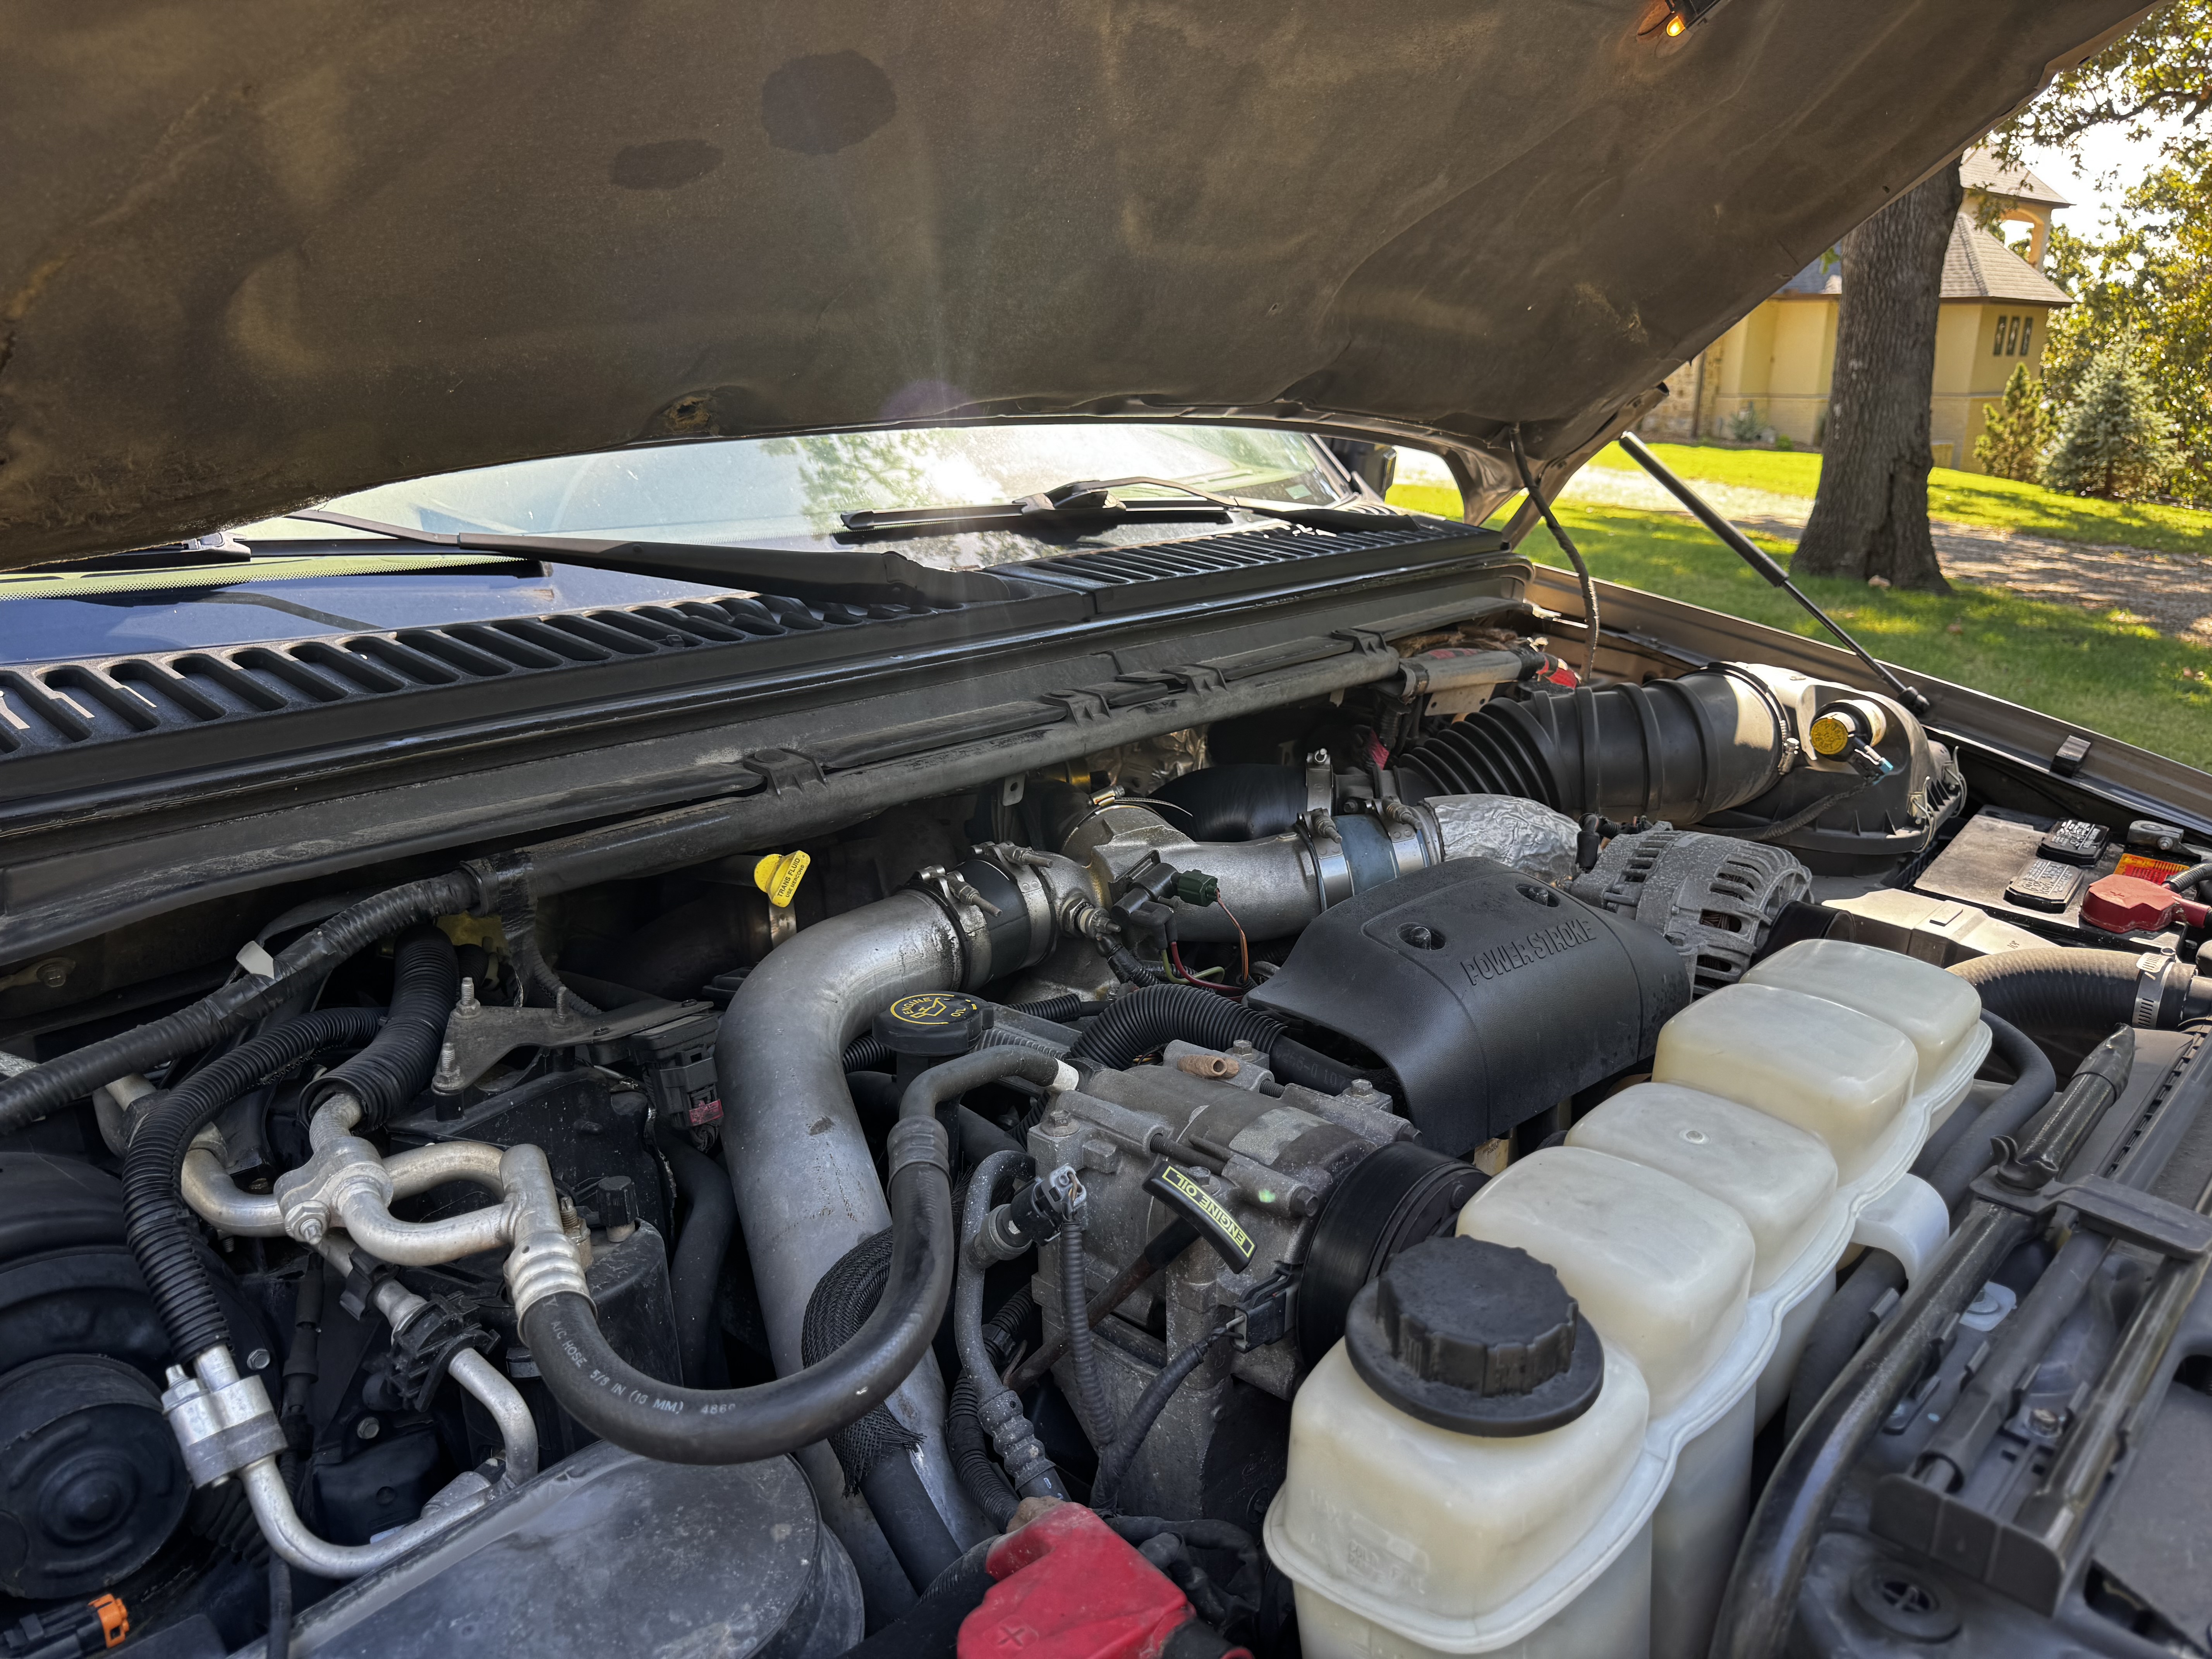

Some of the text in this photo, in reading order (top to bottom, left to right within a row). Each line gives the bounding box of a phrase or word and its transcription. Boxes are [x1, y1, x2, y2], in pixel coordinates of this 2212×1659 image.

[778, 858, 800, 896] TRANS FLUID
[1460, 919, 1596, 986] POWER STROKE
[902, 997, 966, 1017] ENGINE OIL
[1176, 1174, 1245, 1245] ENGINE OIL
[550, 1321, 567, 1339] A/C
[562, 1340, 588, 1369] HOSE
[589, 1369, 610, 1386] 5/8
[610, 1383, 627, 1396] IN
[652, 1398, 684, 1415] MM)
